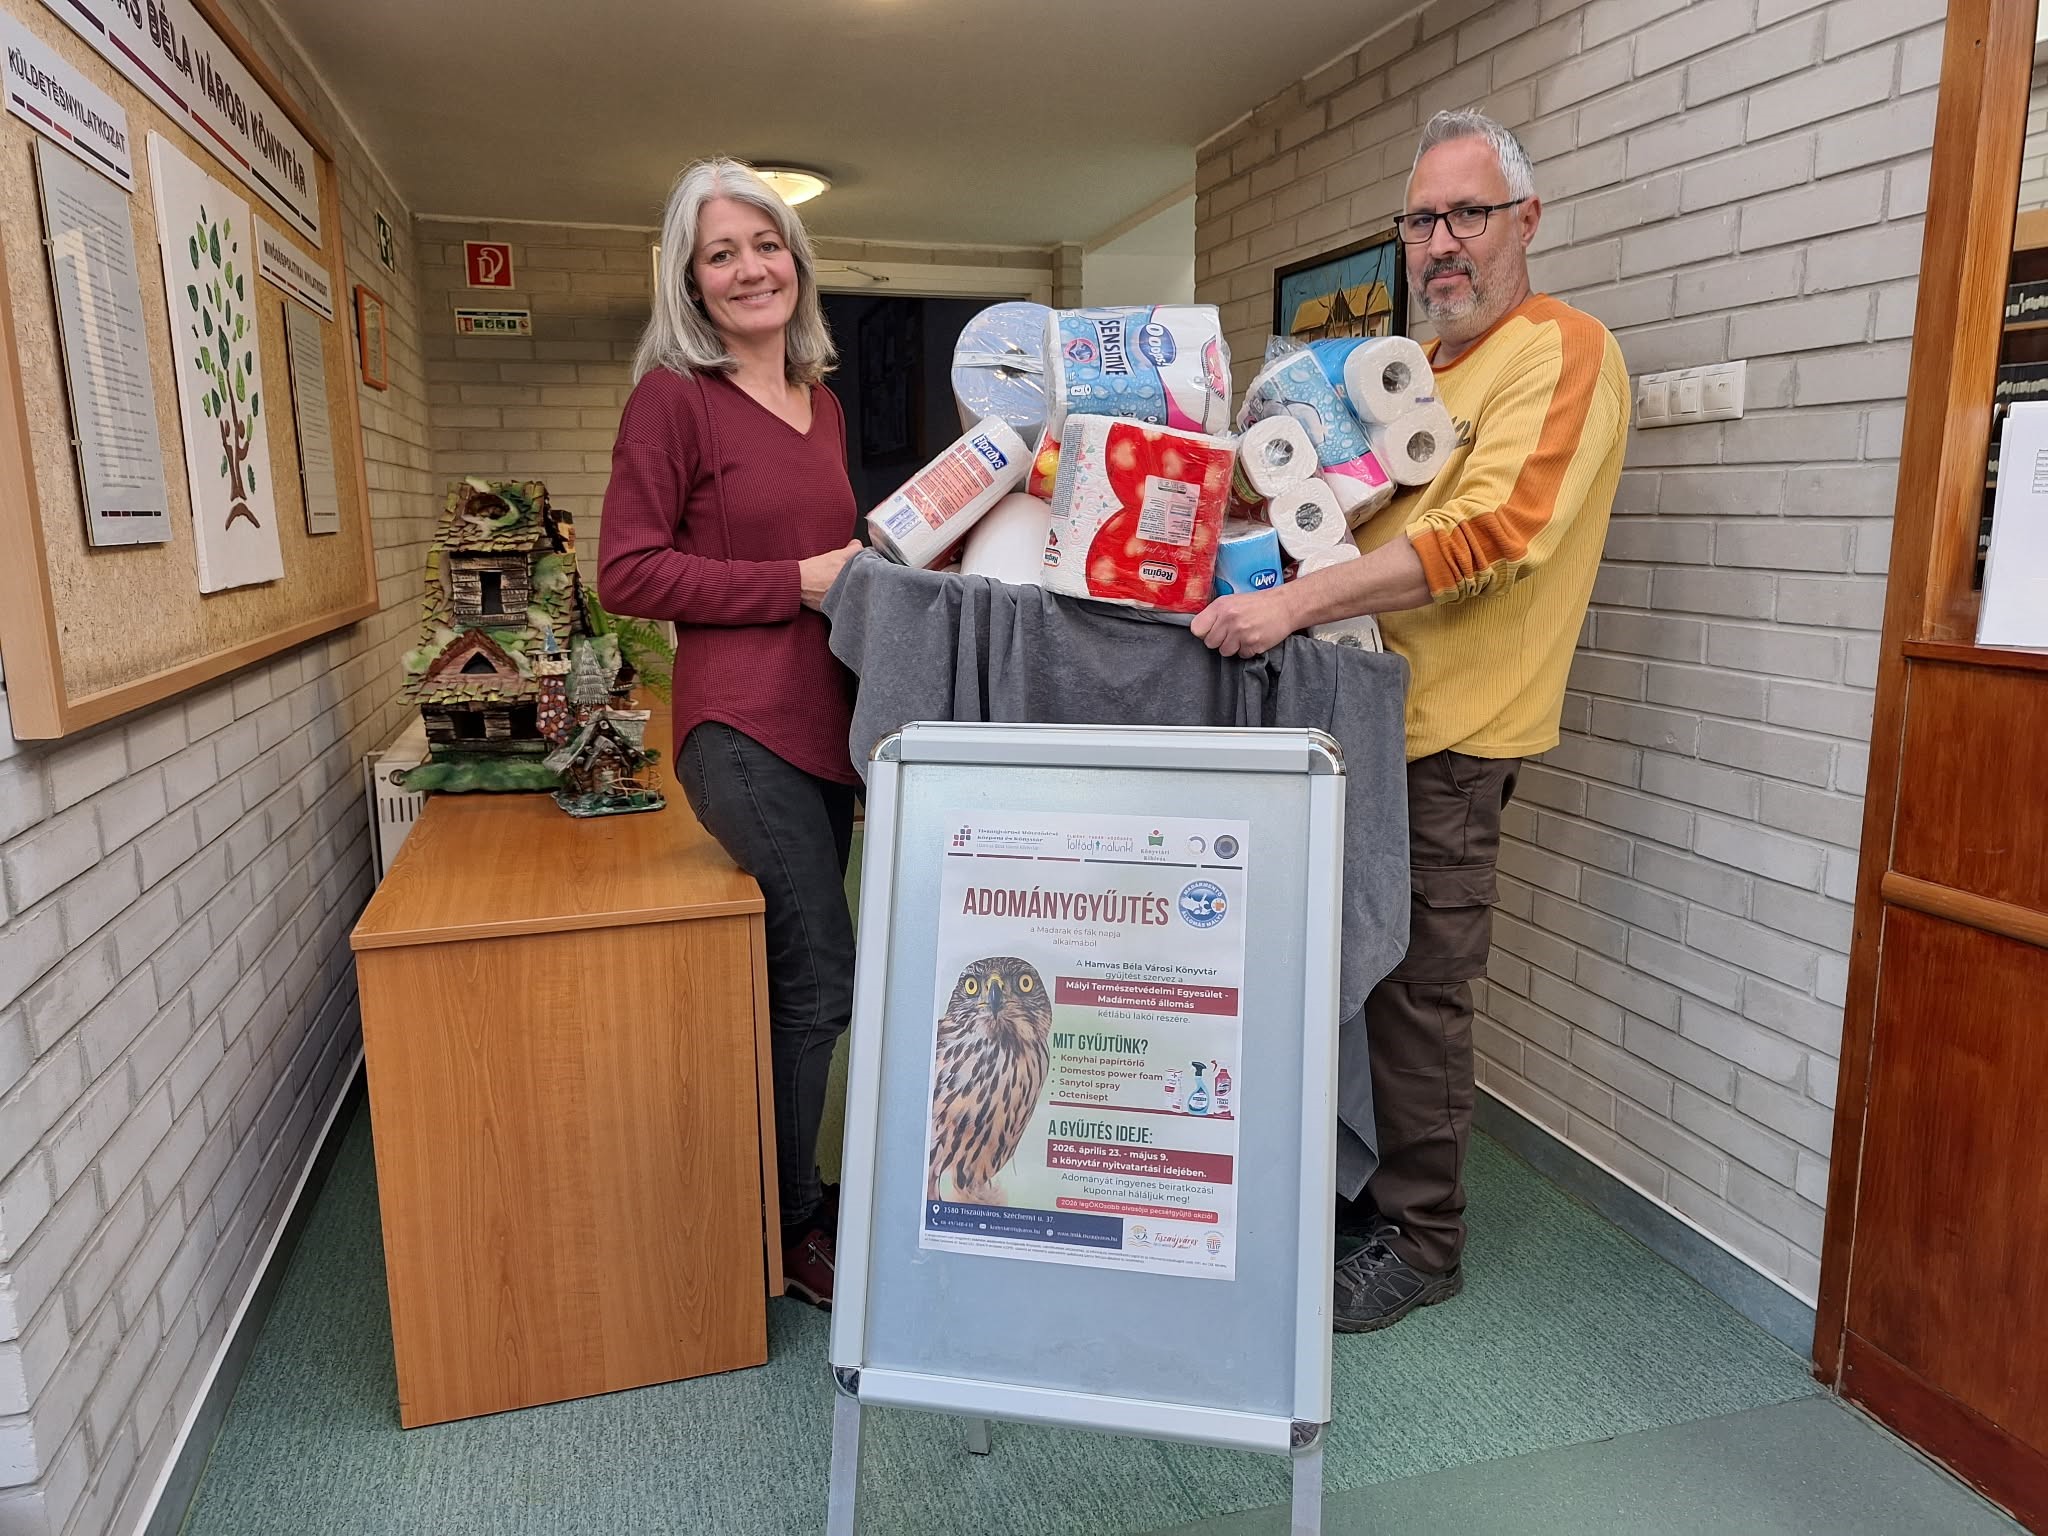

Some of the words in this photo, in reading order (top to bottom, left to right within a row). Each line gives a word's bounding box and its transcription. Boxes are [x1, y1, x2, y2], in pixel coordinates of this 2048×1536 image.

[7, 46, 126, 154] KÜLDETÉSNYILATKOZAT
[147, 0, 195, 84] BÉLA
[195, 48, 250, 140] VÁROSI
[250, 109, 307, 199] KÖNYVTÁR
[1098, 320, 1128, 376] SENSITIVE
[973, 433, 1006, 470] Floralys
[1142, 567, 1174, 581] Regina
[963, 885, 1170, 926] ADOMÁNYGYŰJTÉS
[1036, 926, 1072, 935] Madarak
[1073, 928, 1083, 936] és
[1084, 928, 1097, 936] fák
[1098, 930, 1121, 939] napja
[1053, 938, 1097, 948] alkalmából
[1084, 960, 1120, 970] Hamvas
[1123, 961, 1142, 971] Béla
[1145, 963, 1173, 973] Városi
[1175, 965, 1218, 976] Könyvtár
[1105, 971, 1141, 981] gyűjtést
[1143, 974, 1176, 983] szervez
[1065, 980, 1090, 991] Mályi
[1091, 982, 1175, 996] Természetvédelmi
[1177, 988, 1223, 1000] Egyesület
[1097, 995, 1157, 1007] Madármentő
[1158, 999, 1195, 1009] állomás
[1097, 1009, 1131, 1019] kétlábú
[1133, 1011, 1154, 1021] lakói
[1156, 1014, 1191, 1024] részére.
[1053, 1033, 1075, 1049] MIT
[1078, 1033, 1149, 1055] GYŰJTÜNK?
[1060, 1054, 1097, 1064] Konyhai
[1099, 1057, 1145, 1068] papírtörlő
[1060, 1066, 1106, 1077] Domestos
[1107, 1070, 1137, 1079] power
[1139, 1071, 1163, 1081] foam
[1059, 1078, 1093, 1089] Sanytol
[1095, 1082, 1121, 1091] spray
[1058, 1090, 1109, 1102] Octenisept
[1048, 1119, 1057, 1135] A
[1060, 1118, 1113, 1141] GYŰJTÉS
[1116, 1124, 1153, 1144] IDEJE:
[1052, 1143, 1077, 1153] 2026.
[1078, 1146, 1107, 1156] április
[1108, 1148, 1122, 1157] 23.
[1129, 1151, 1158, 1162] május
[1159, 1153, 1169, 1162] 9.
[1060, 1156, 1101, 1168] könyvtár
[1102, 1161, 1161, 1174] nyitvatartási
[1163, 1166, 1207, 1178] idejében.
[1061, 1172, 1113, 1186] Adományát
[1115, 1179, 1156, 1190] ingyenes
[1159, 1182, 1214, 1195] beiratkozási
[1083, 1186, 1126, 1198] kuponnal
[1128, 1189, 1164, 1201] háláljuk
[1166, 1194, 1190, 1204] meg!
[943, 1206, 959, 1214] 3580
